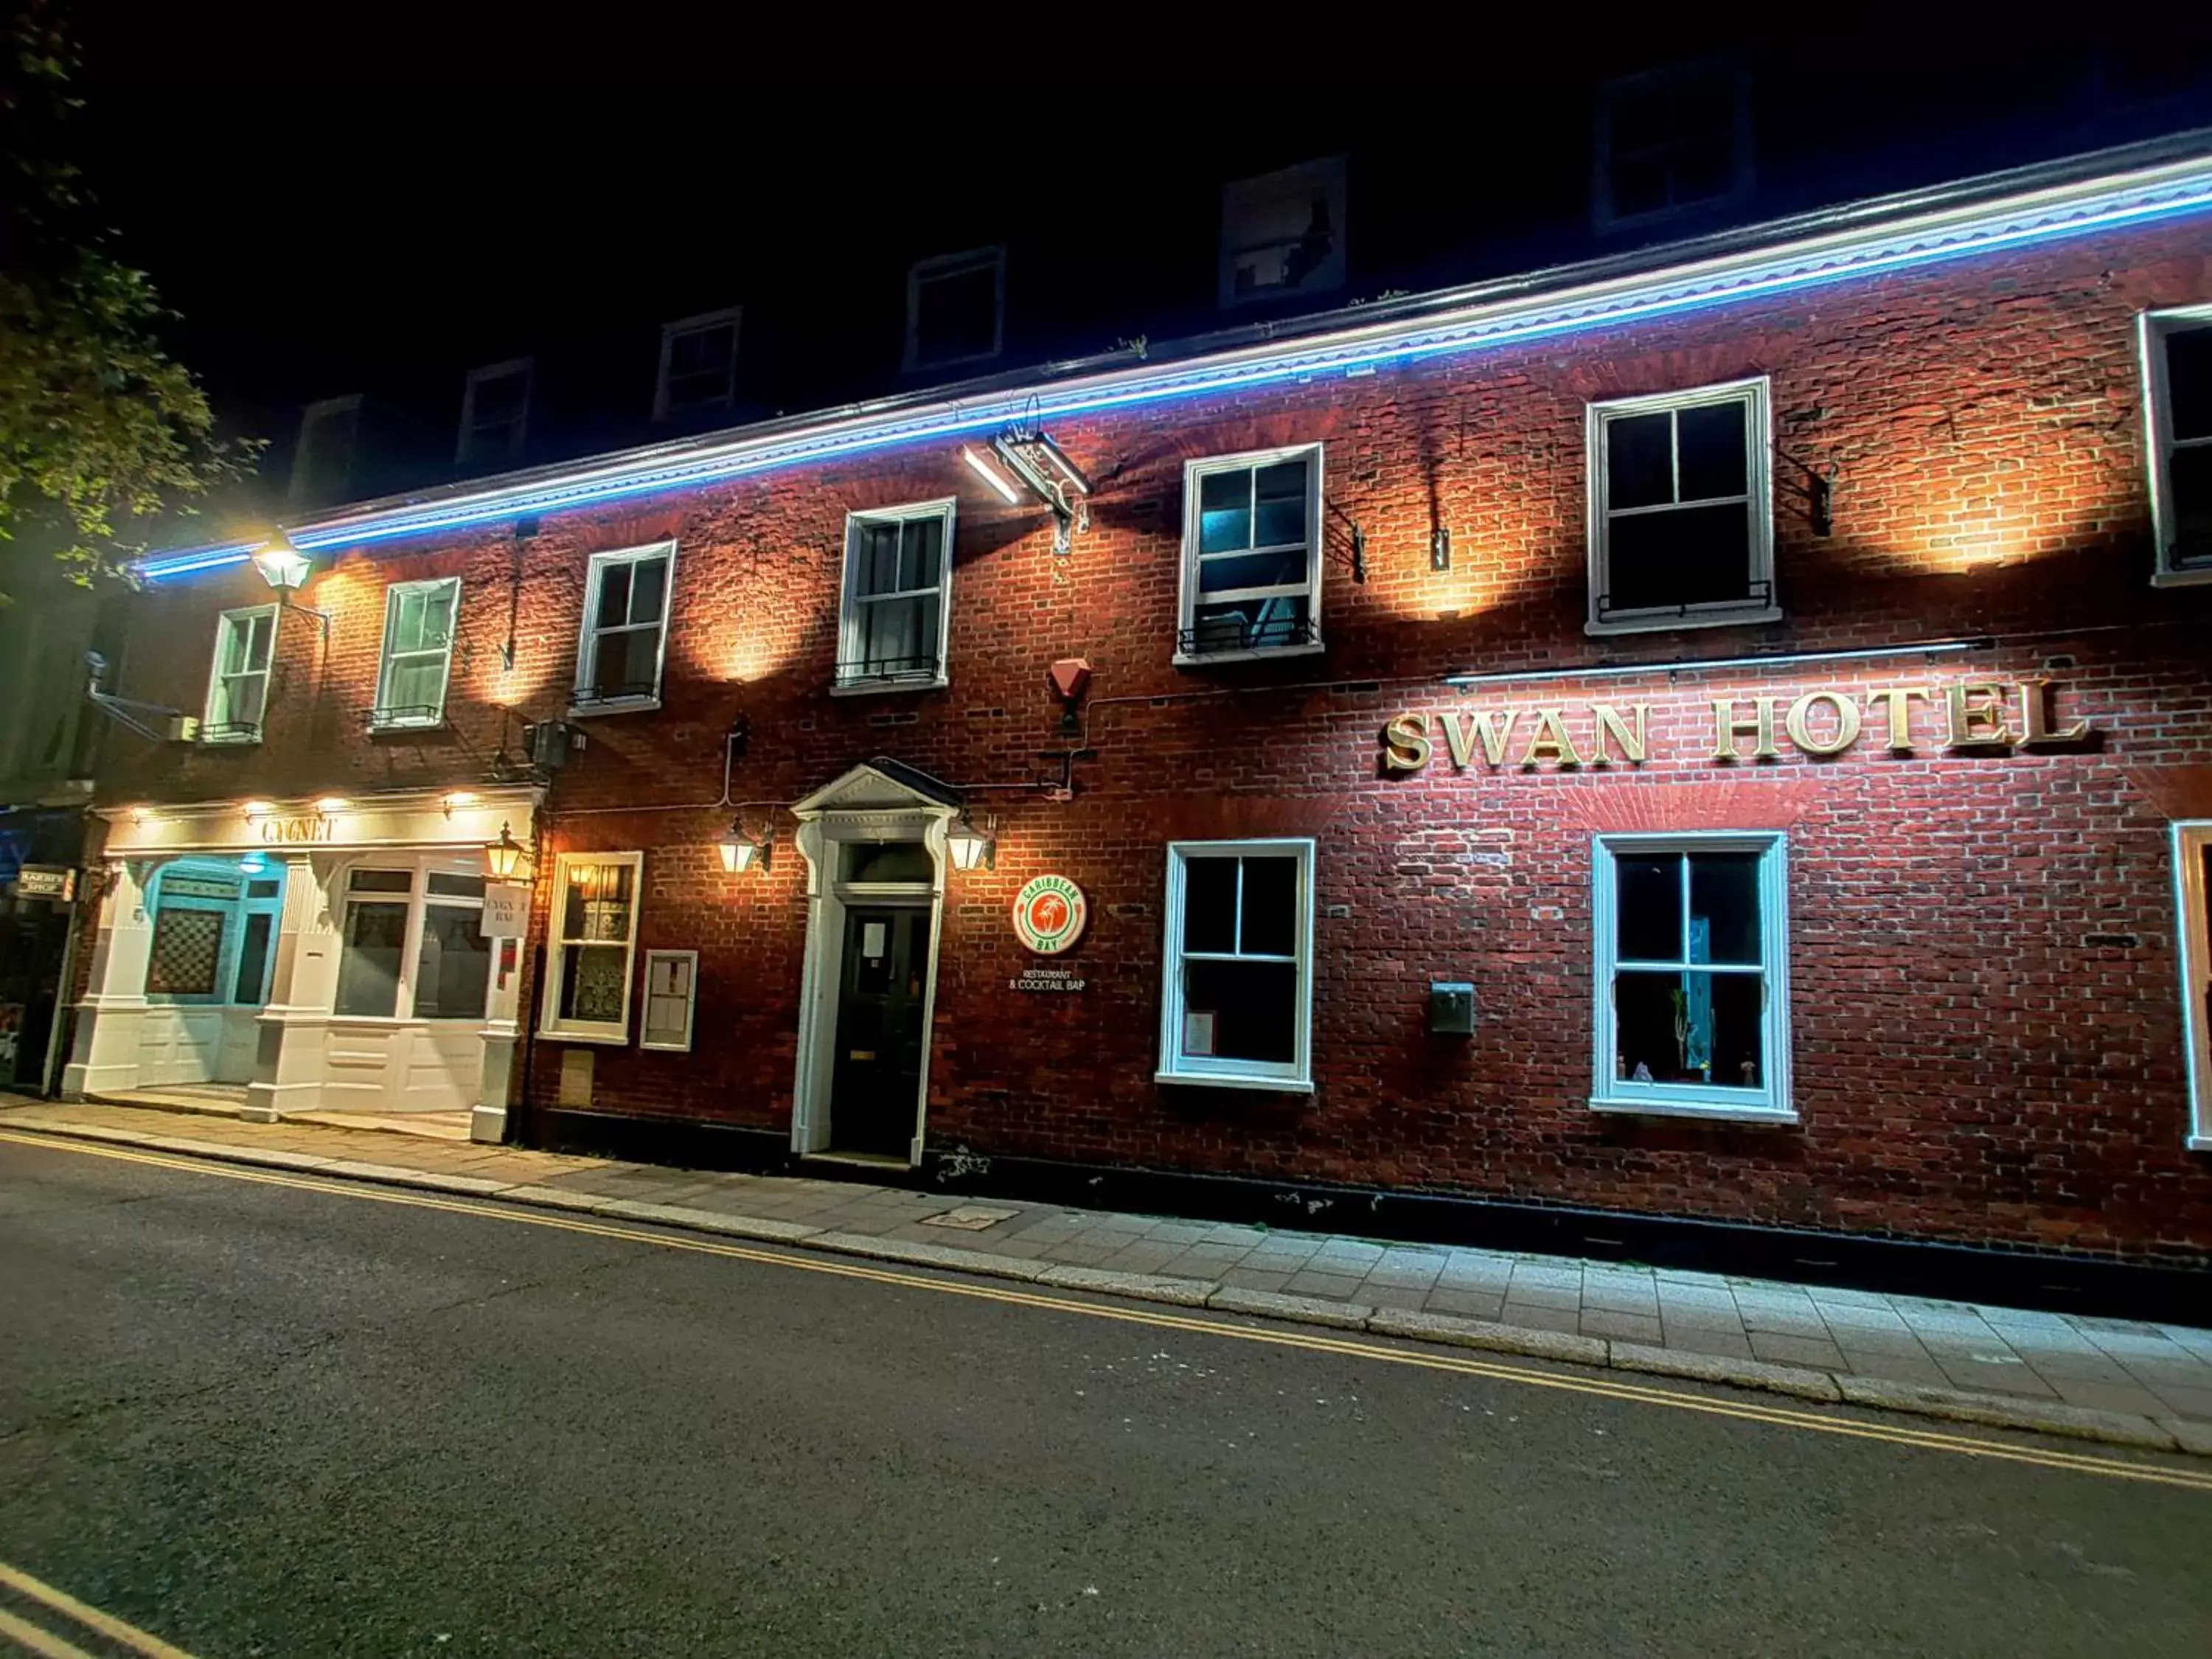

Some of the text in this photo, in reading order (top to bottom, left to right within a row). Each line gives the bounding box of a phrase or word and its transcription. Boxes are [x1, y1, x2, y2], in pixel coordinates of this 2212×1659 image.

[1387, 678, 2086, 770] SWAN HOTEL
[262, 818, 338, 842] CYGNET
[1023, 877, 1079, 900] CARIBBEAN
[486, 900, 526, 911] CYGNT
[1037, 939, 1057, 950] BAY
[1022, 970, 1071, 980] RESTAURANT
[1018, 979, 1064, 990] COCKTAIL
